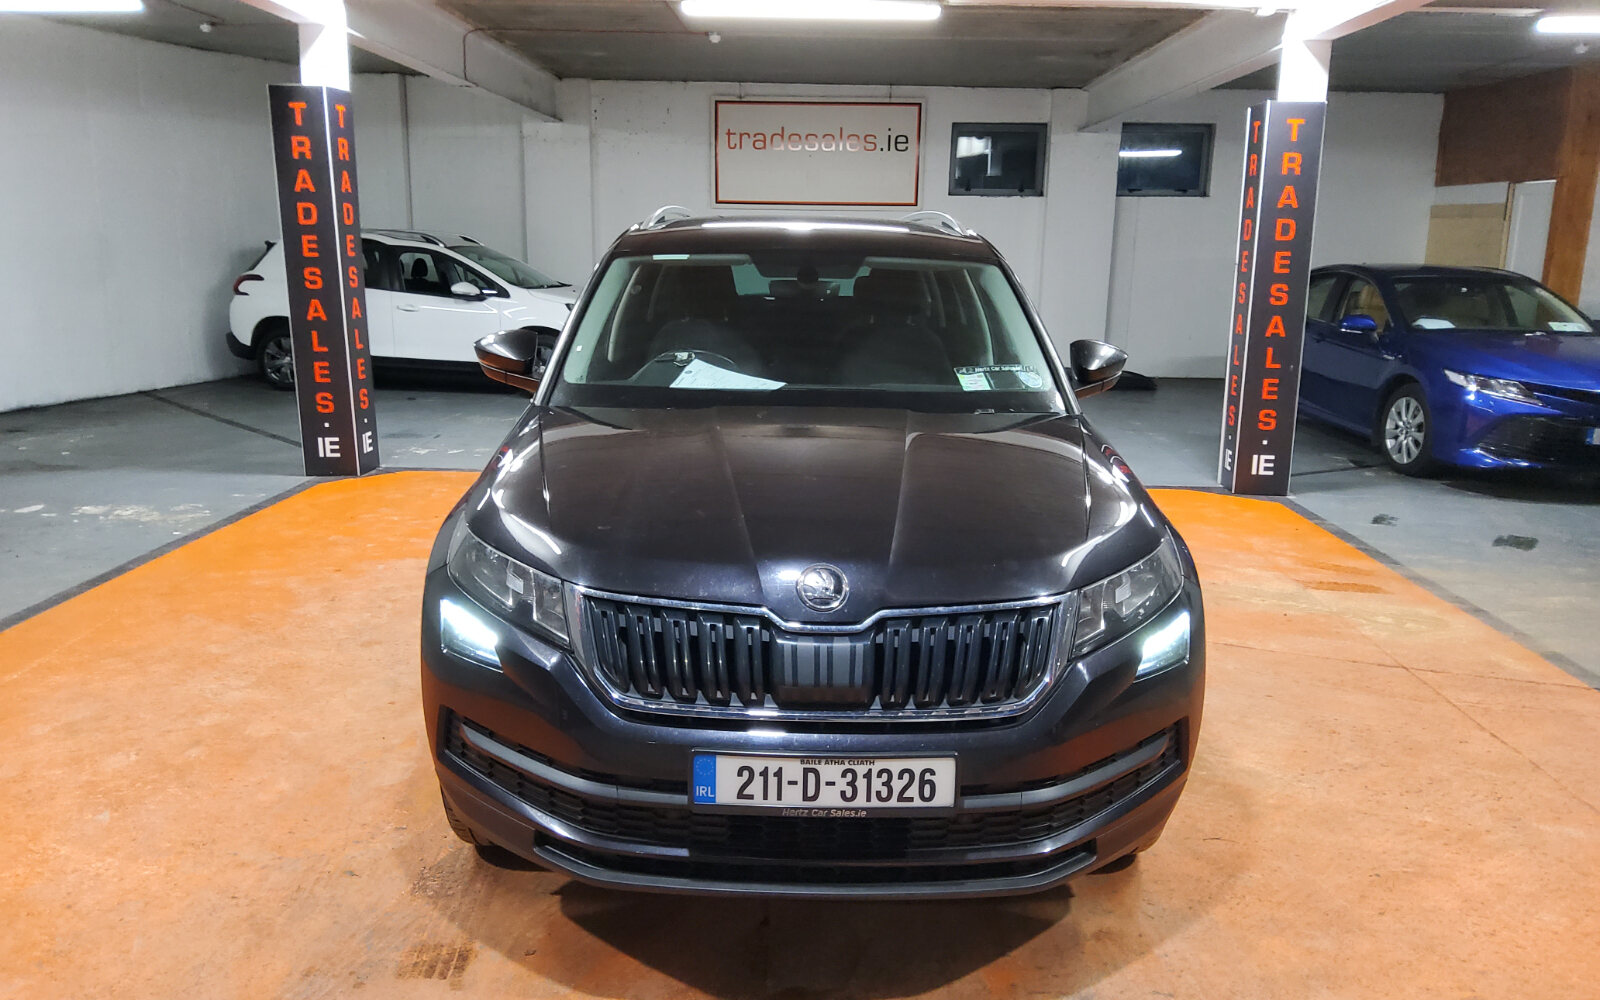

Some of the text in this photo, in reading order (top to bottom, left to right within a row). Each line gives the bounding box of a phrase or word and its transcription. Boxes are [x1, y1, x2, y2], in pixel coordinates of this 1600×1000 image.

[725, 126, 909, 152] tradesales.ie
[696, 785, 715, 798] IRL
[736, 765, 937, 803] 211-D-31326
[782, 808, 867, 817] Hertz Car Sales.ie
